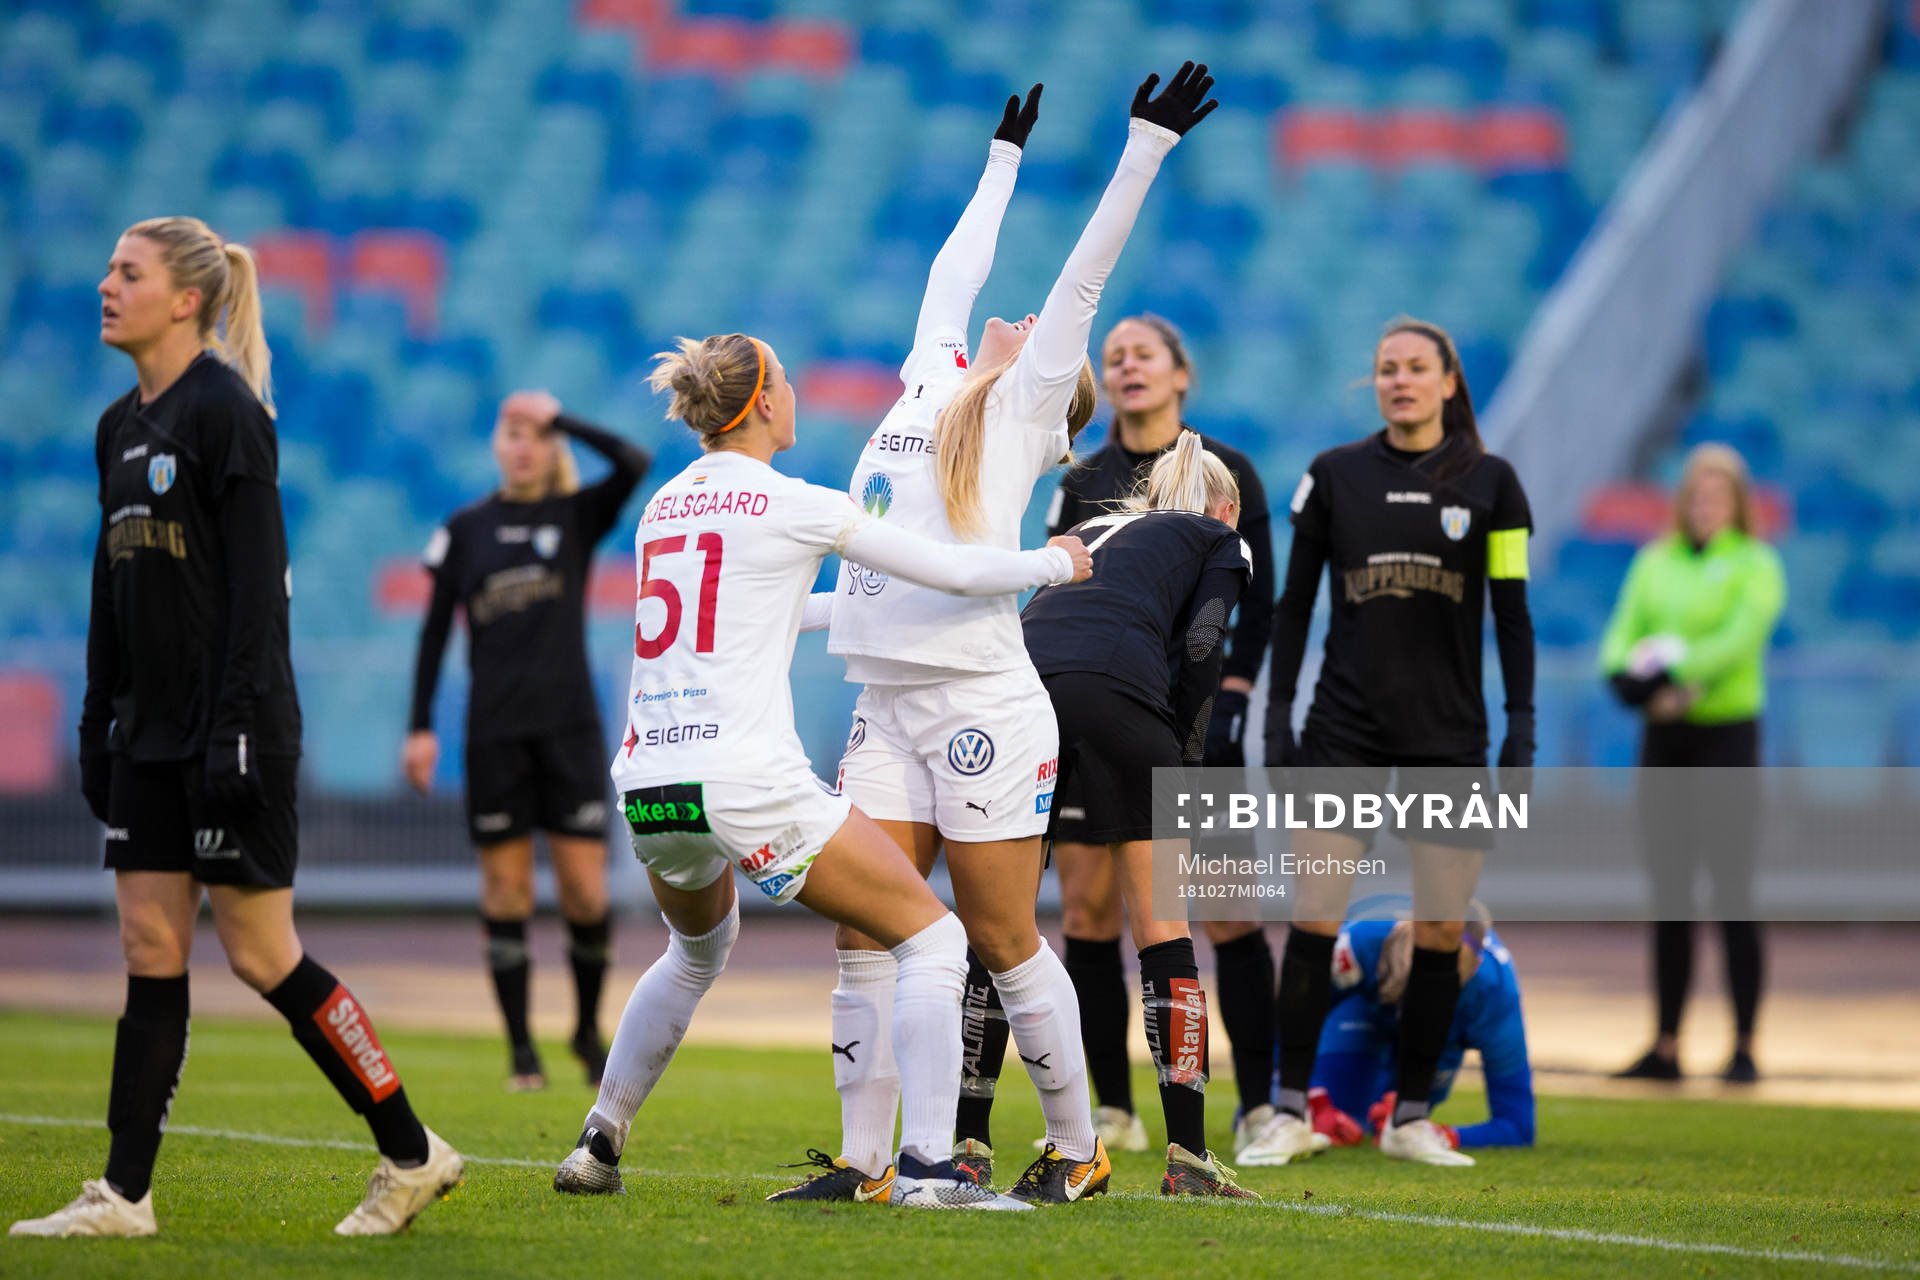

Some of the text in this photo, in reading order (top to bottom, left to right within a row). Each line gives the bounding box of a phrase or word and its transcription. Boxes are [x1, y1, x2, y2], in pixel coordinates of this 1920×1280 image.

[635, 532, 723, 659] 51
[626, 798, 679, 823] akea
[327, 997, 394, 1089] Stavdal
[1176, 986, 1202, 1072] Stavdal
